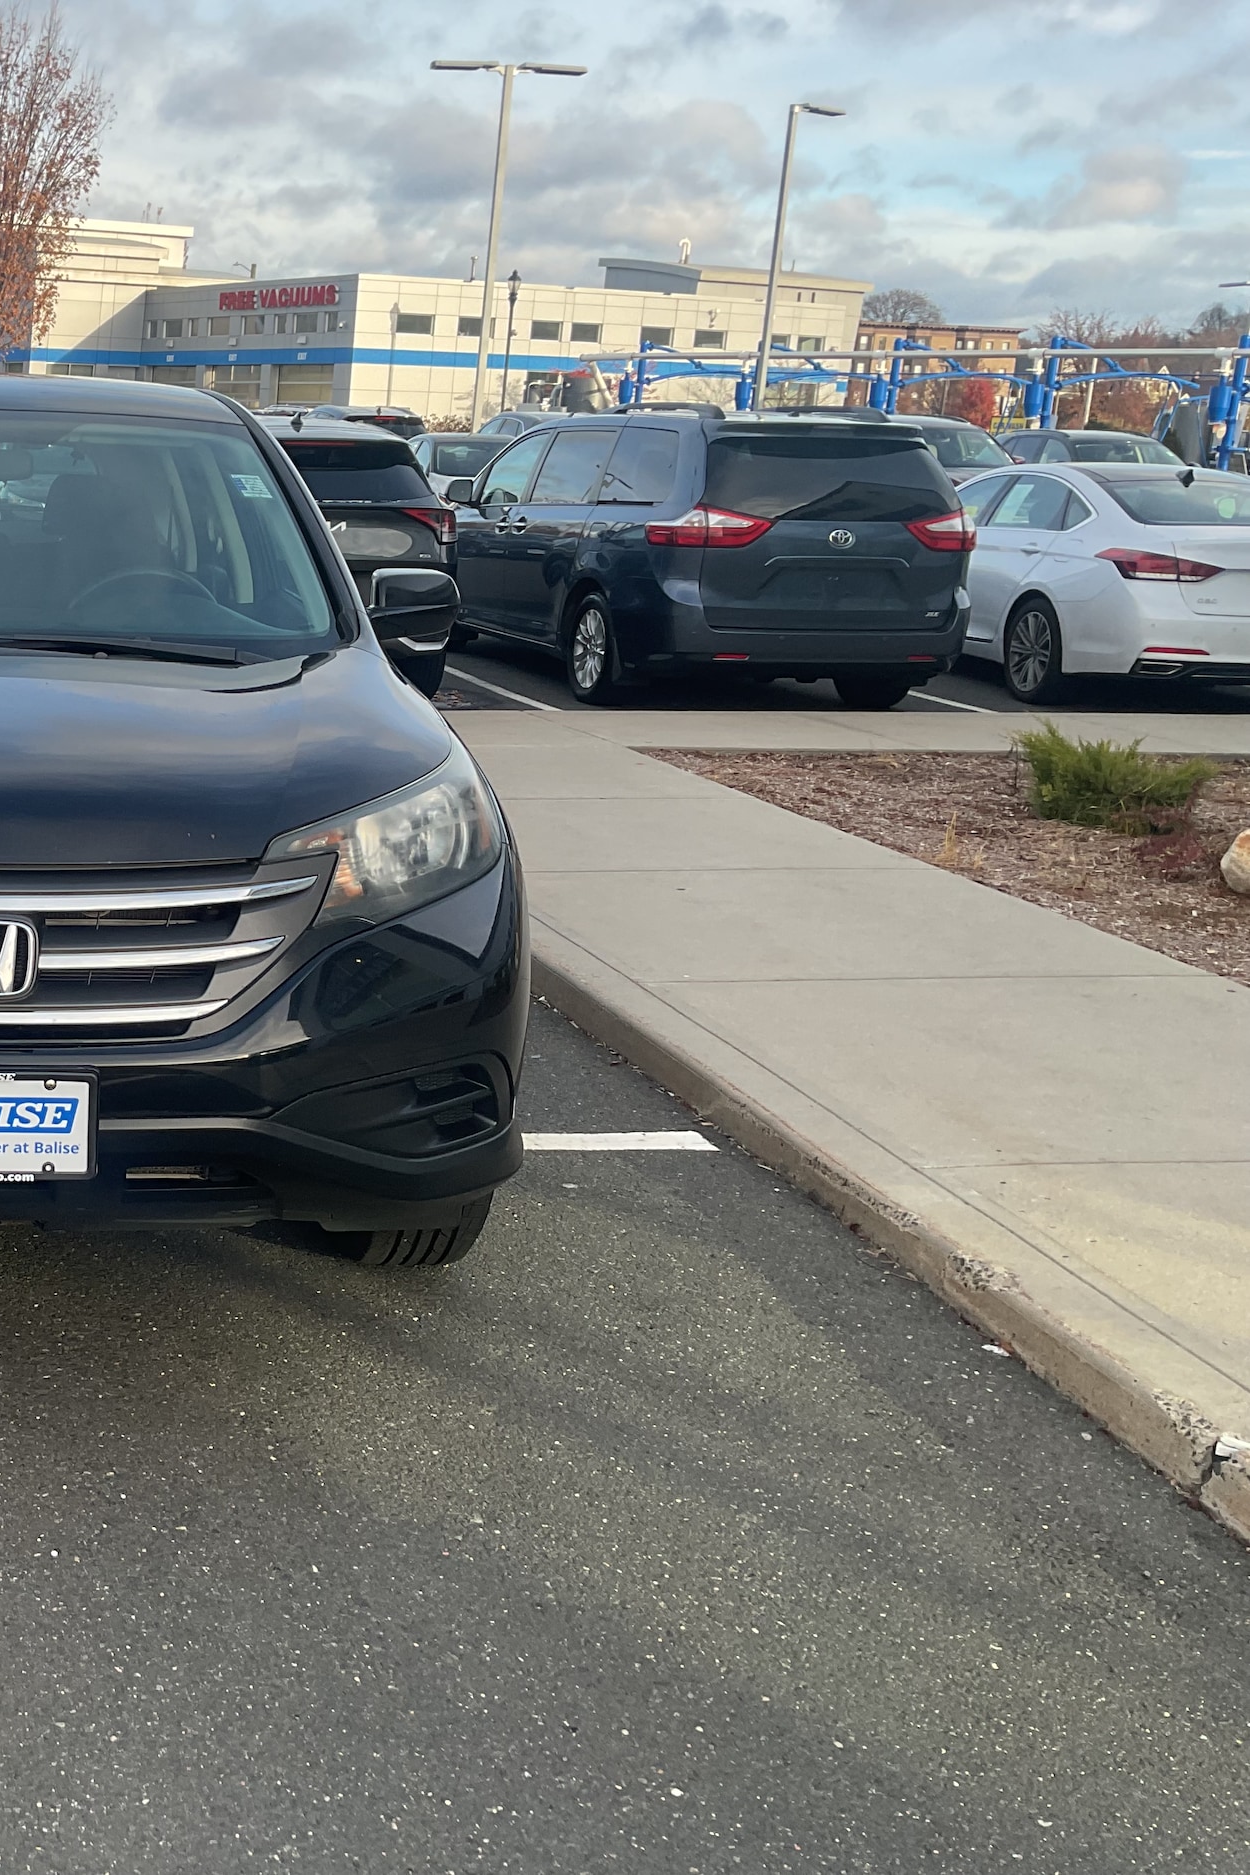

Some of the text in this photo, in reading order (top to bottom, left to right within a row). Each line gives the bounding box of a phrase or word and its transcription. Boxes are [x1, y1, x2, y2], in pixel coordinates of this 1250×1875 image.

[219, 284, 339, 310] FREE VACUUMS
[13, 1142, 29, 1154] at
[34, 1142, 80, 1154] Balise
